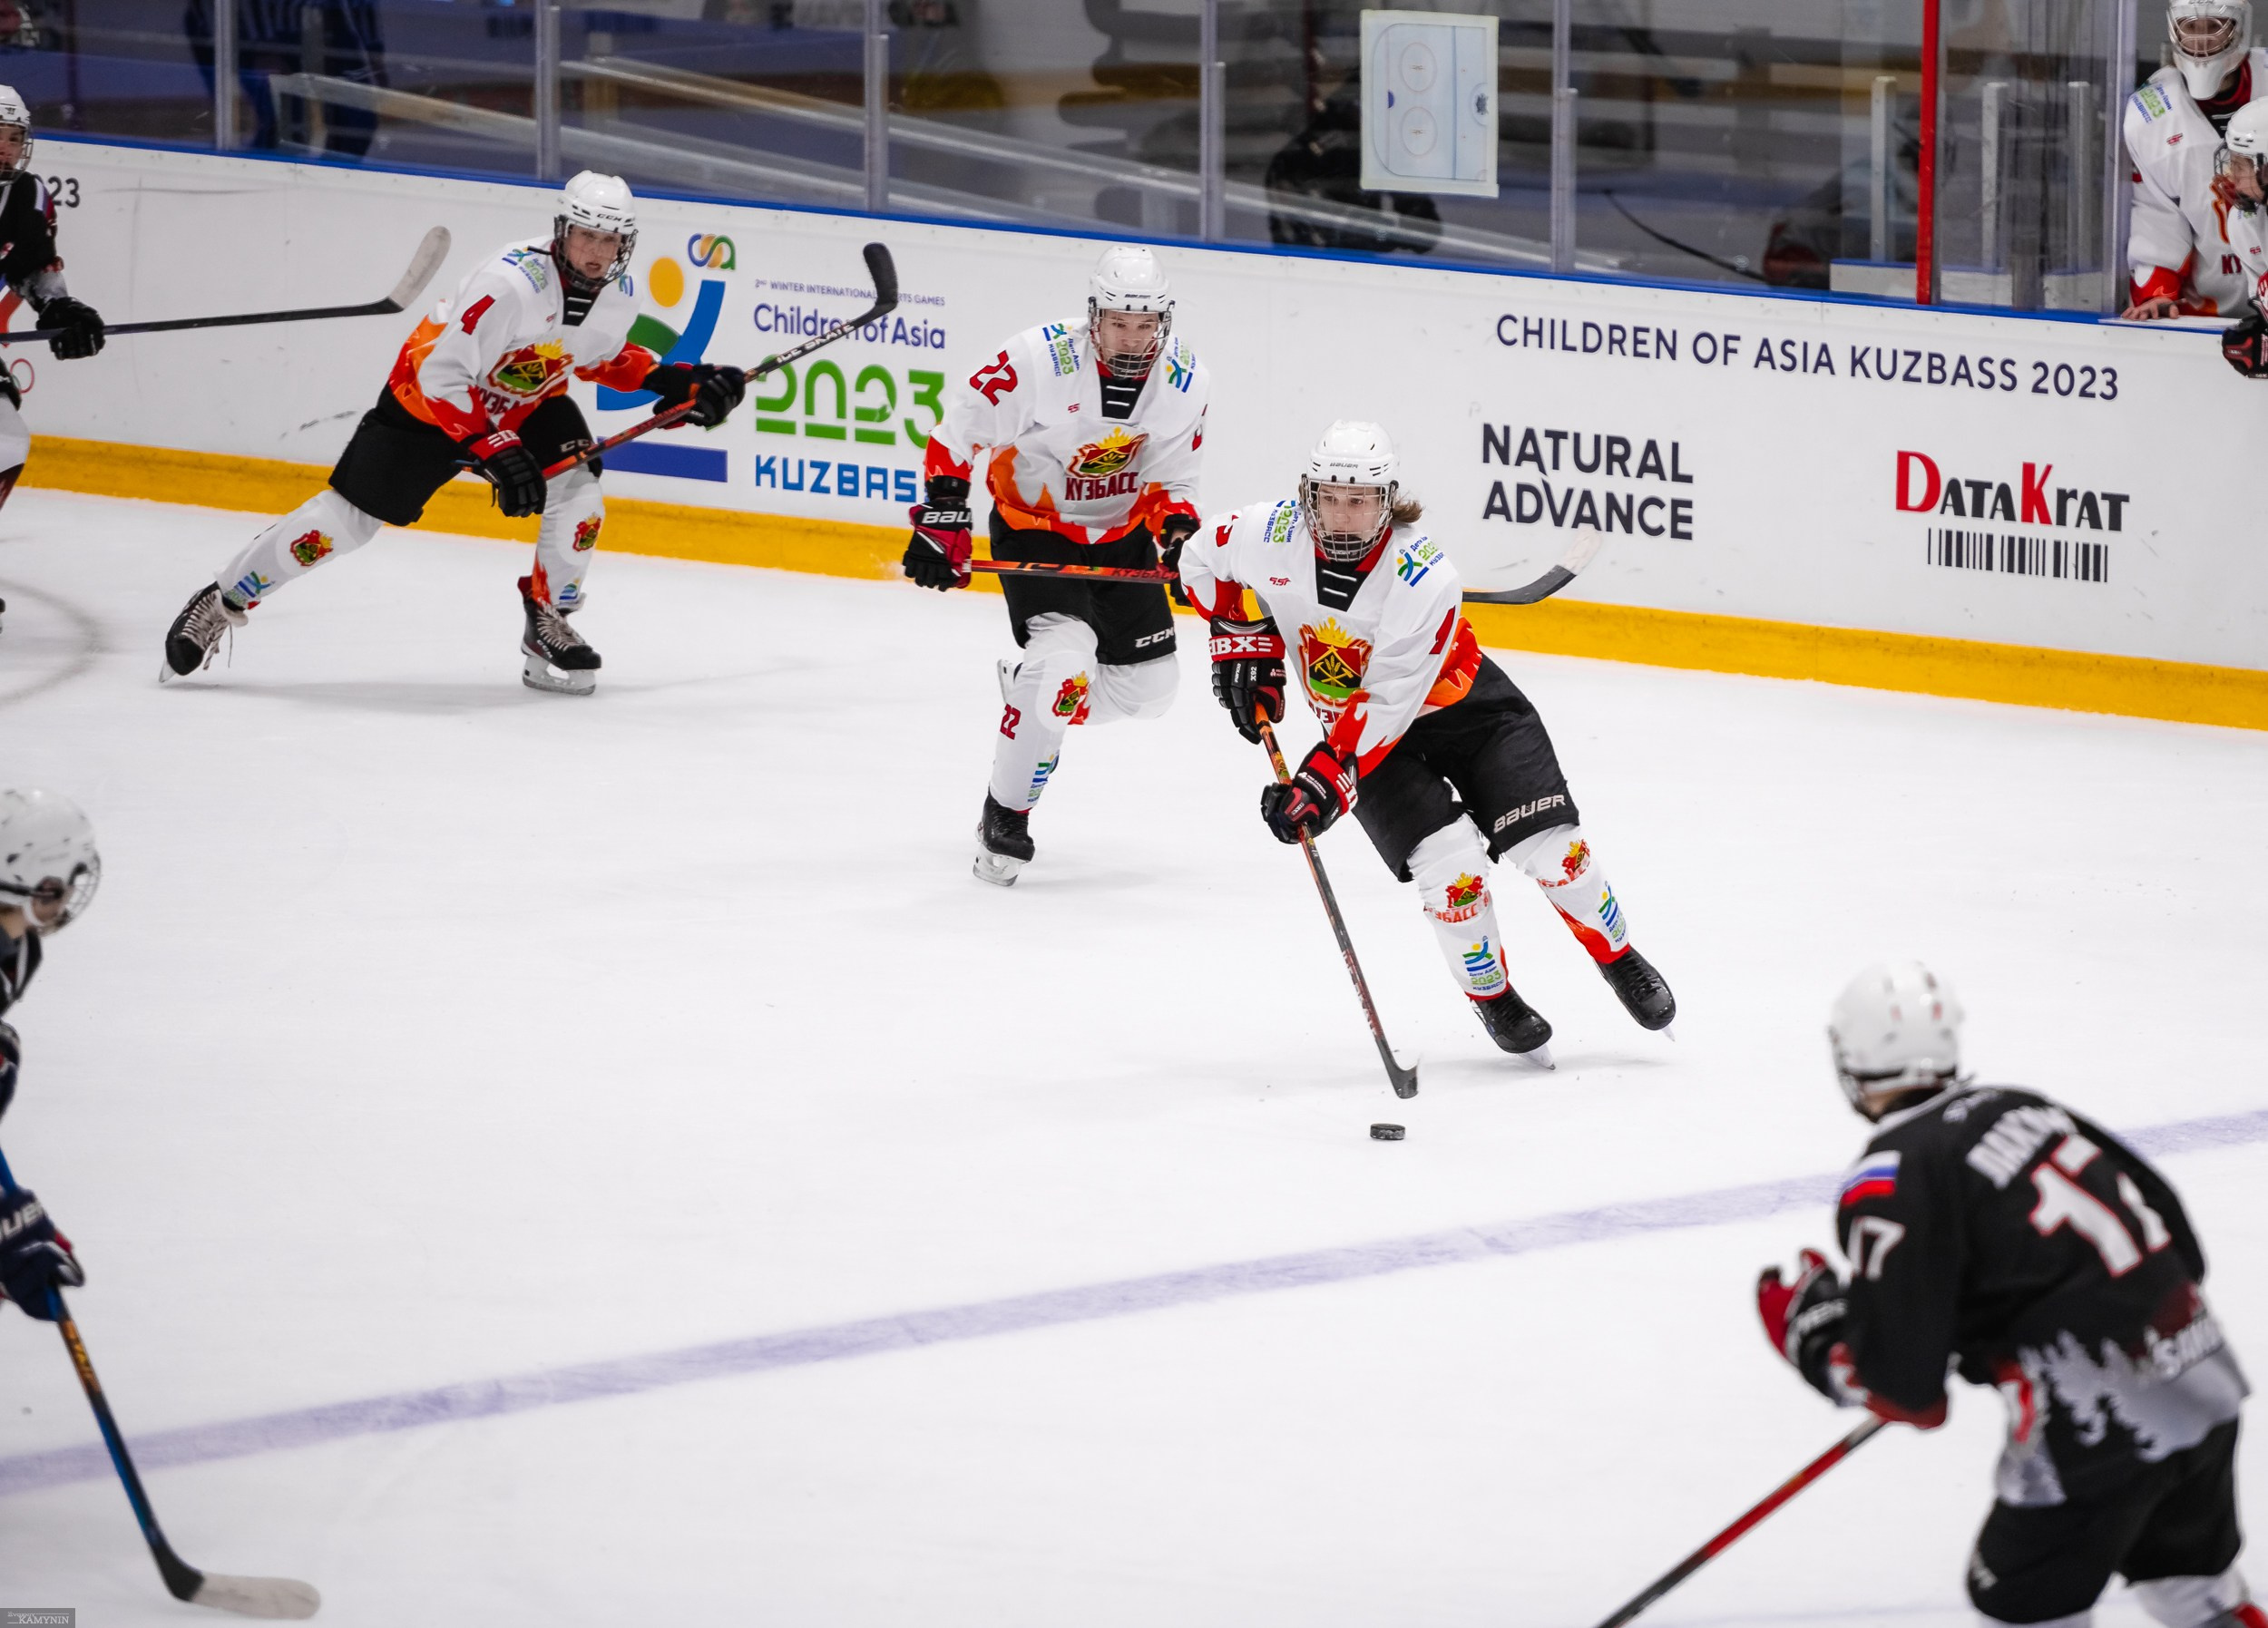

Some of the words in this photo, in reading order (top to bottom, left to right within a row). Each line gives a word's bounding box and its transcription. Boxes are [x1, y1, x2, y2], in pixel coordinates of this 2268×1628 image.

[770, 280, 805, 293] WINTER
[806, 284, 878, 299] INTERNATIONAL
[914, 295, 945, 307] GAMES
[461, 294, 496, 336] 4
[863, 314, 889, 345] of
[891, 317, 945, 349] Asia
[1496, 314, 1677, 362] CHILDREN
[1693, 331, 1741, 366] OF
[1754, 337, 1836, 376] ASIA
[1850, 345, 2018, 392] KUZBASS
[2031, 361, 2119, 401] 2023
[969, 350, 1019, 406] 22
[756, 354, 945, 451] 2023
[1482, 422, 1695, 484] NATURAL
[756, 454, 929, 504] KUZBAS
[1065, 472, 1139, 502] КУЗБАСС
[922, 508, 972, 524] BAU
[1482, 477, 1694, 541] ADVANCE
[1000, 704, 1022, 740] 22
[1493, 794, 1567, 833] BAUER
[1471, 969, 1502, 986] 2023
